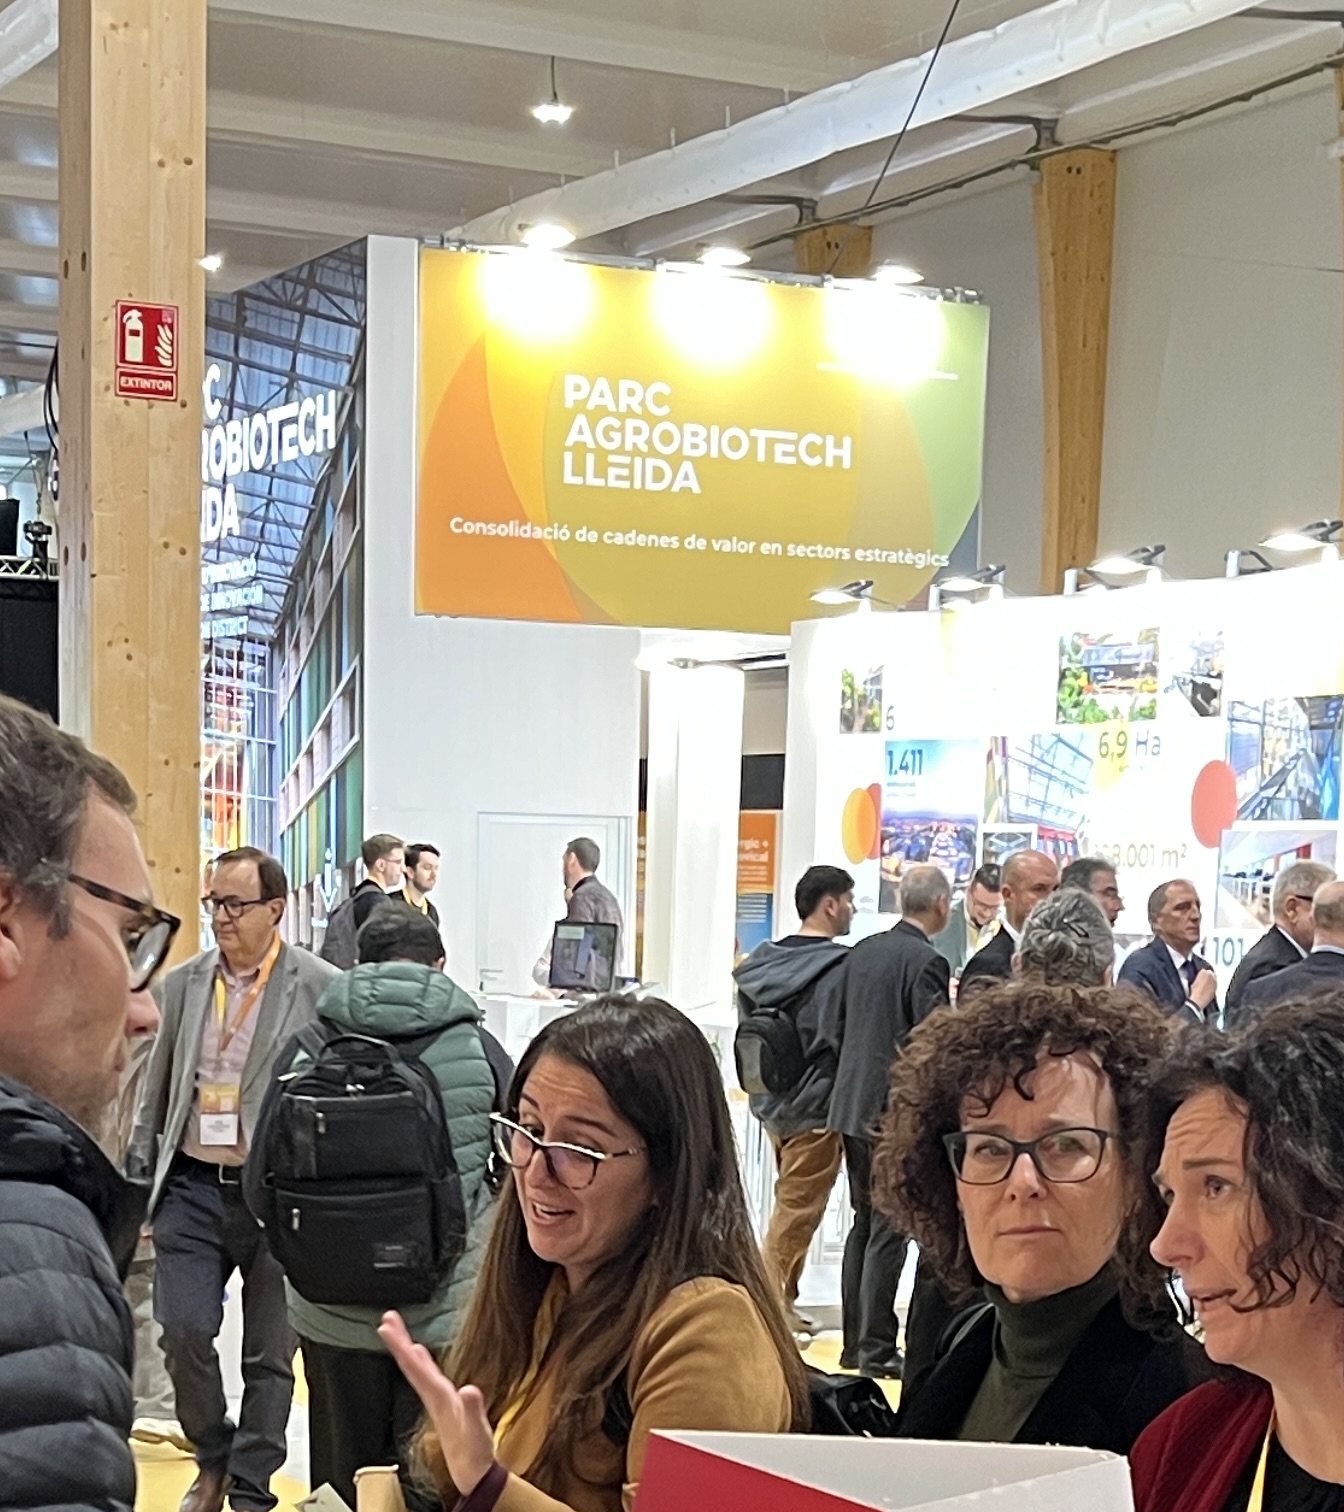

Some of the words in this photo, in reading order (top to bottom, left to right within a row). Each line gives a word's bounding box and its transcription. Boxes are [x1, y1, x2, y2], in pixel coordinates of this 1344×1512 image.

[119, 376, 173, 392] EXTINTOR
[563, 375, 672, 416] PARC
[564, 416, 852, 469] AGROBIOTECH
[562, 452, 702, 494] LLEIDA
[449, 515, 570, 543] Consolidació
[575, 525, 599, 544] de
[603, 527, 680, 550] cadenes
[684, 531, 708, 552] de
[711, 534, 756, 556] valor
[760, 540, 783, 556] en
[787, 539, 851, 561] sectors
[855, 545, 950, 569] estratègics
[887, 748, 924, 777] 1.411
[1098, 730, 1129, 761] 6,9
[1134, 730, 1162, 757] Ha
[1095, 843, 1155, 869] 8.001
